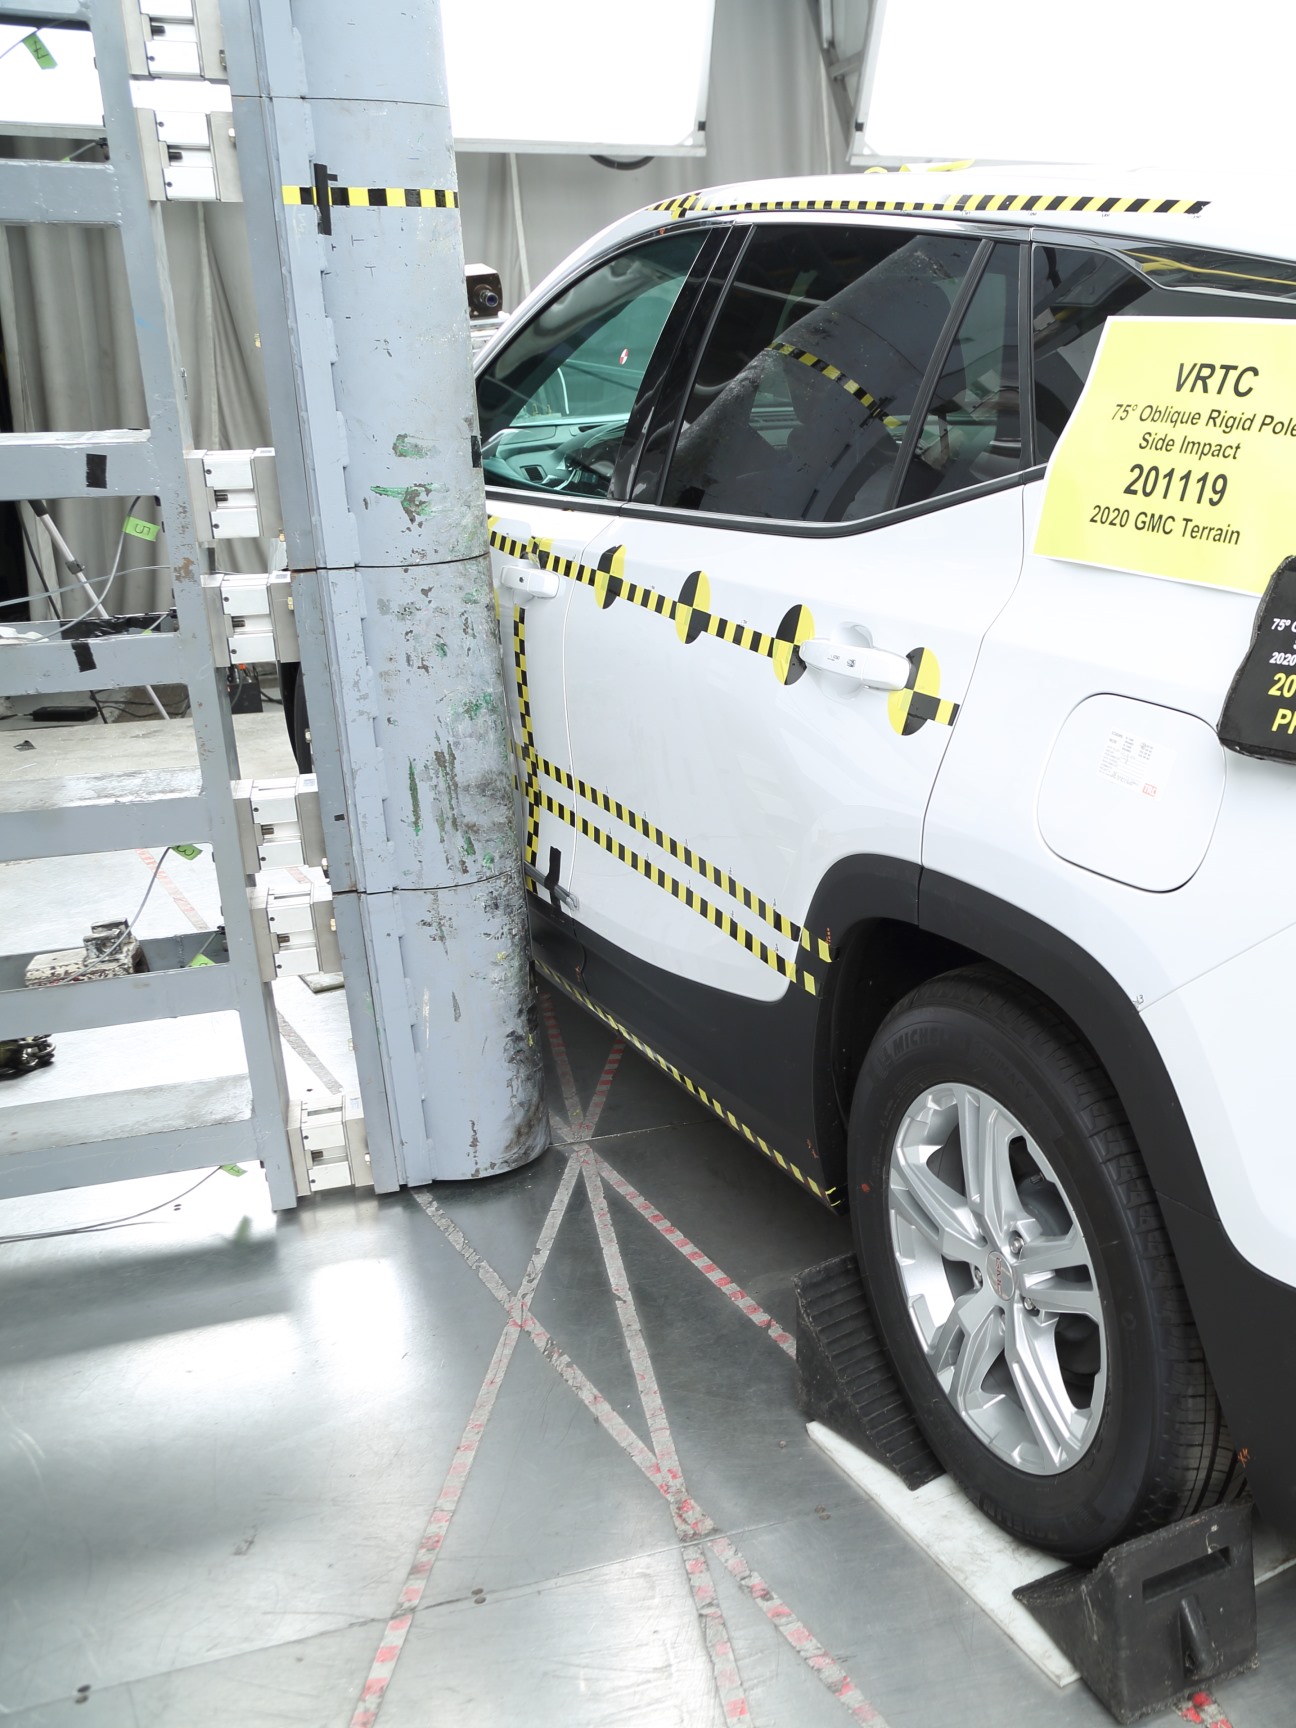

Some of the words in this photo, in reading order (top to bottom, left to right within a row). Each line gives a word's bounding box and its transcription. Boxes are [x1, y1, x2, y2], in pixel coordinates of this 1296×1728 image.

[1175, 362, 1260, 398] VRTC
[1139, 402, 1202, 428] Oblique
[1205, 408, 1257, 434] Rigid
[1138, 431, 1176, 454] Side
[1179, 435, 1242, 462] Impact
[1122, 463, 1229, 507] 201119
[1089, 504, 1130, 528] 2020
[1134, 511, 1177, 536] GMC
[1182, 517, 1241, 545] Terrain
[995, 1257, 1004, 1297] GMC
